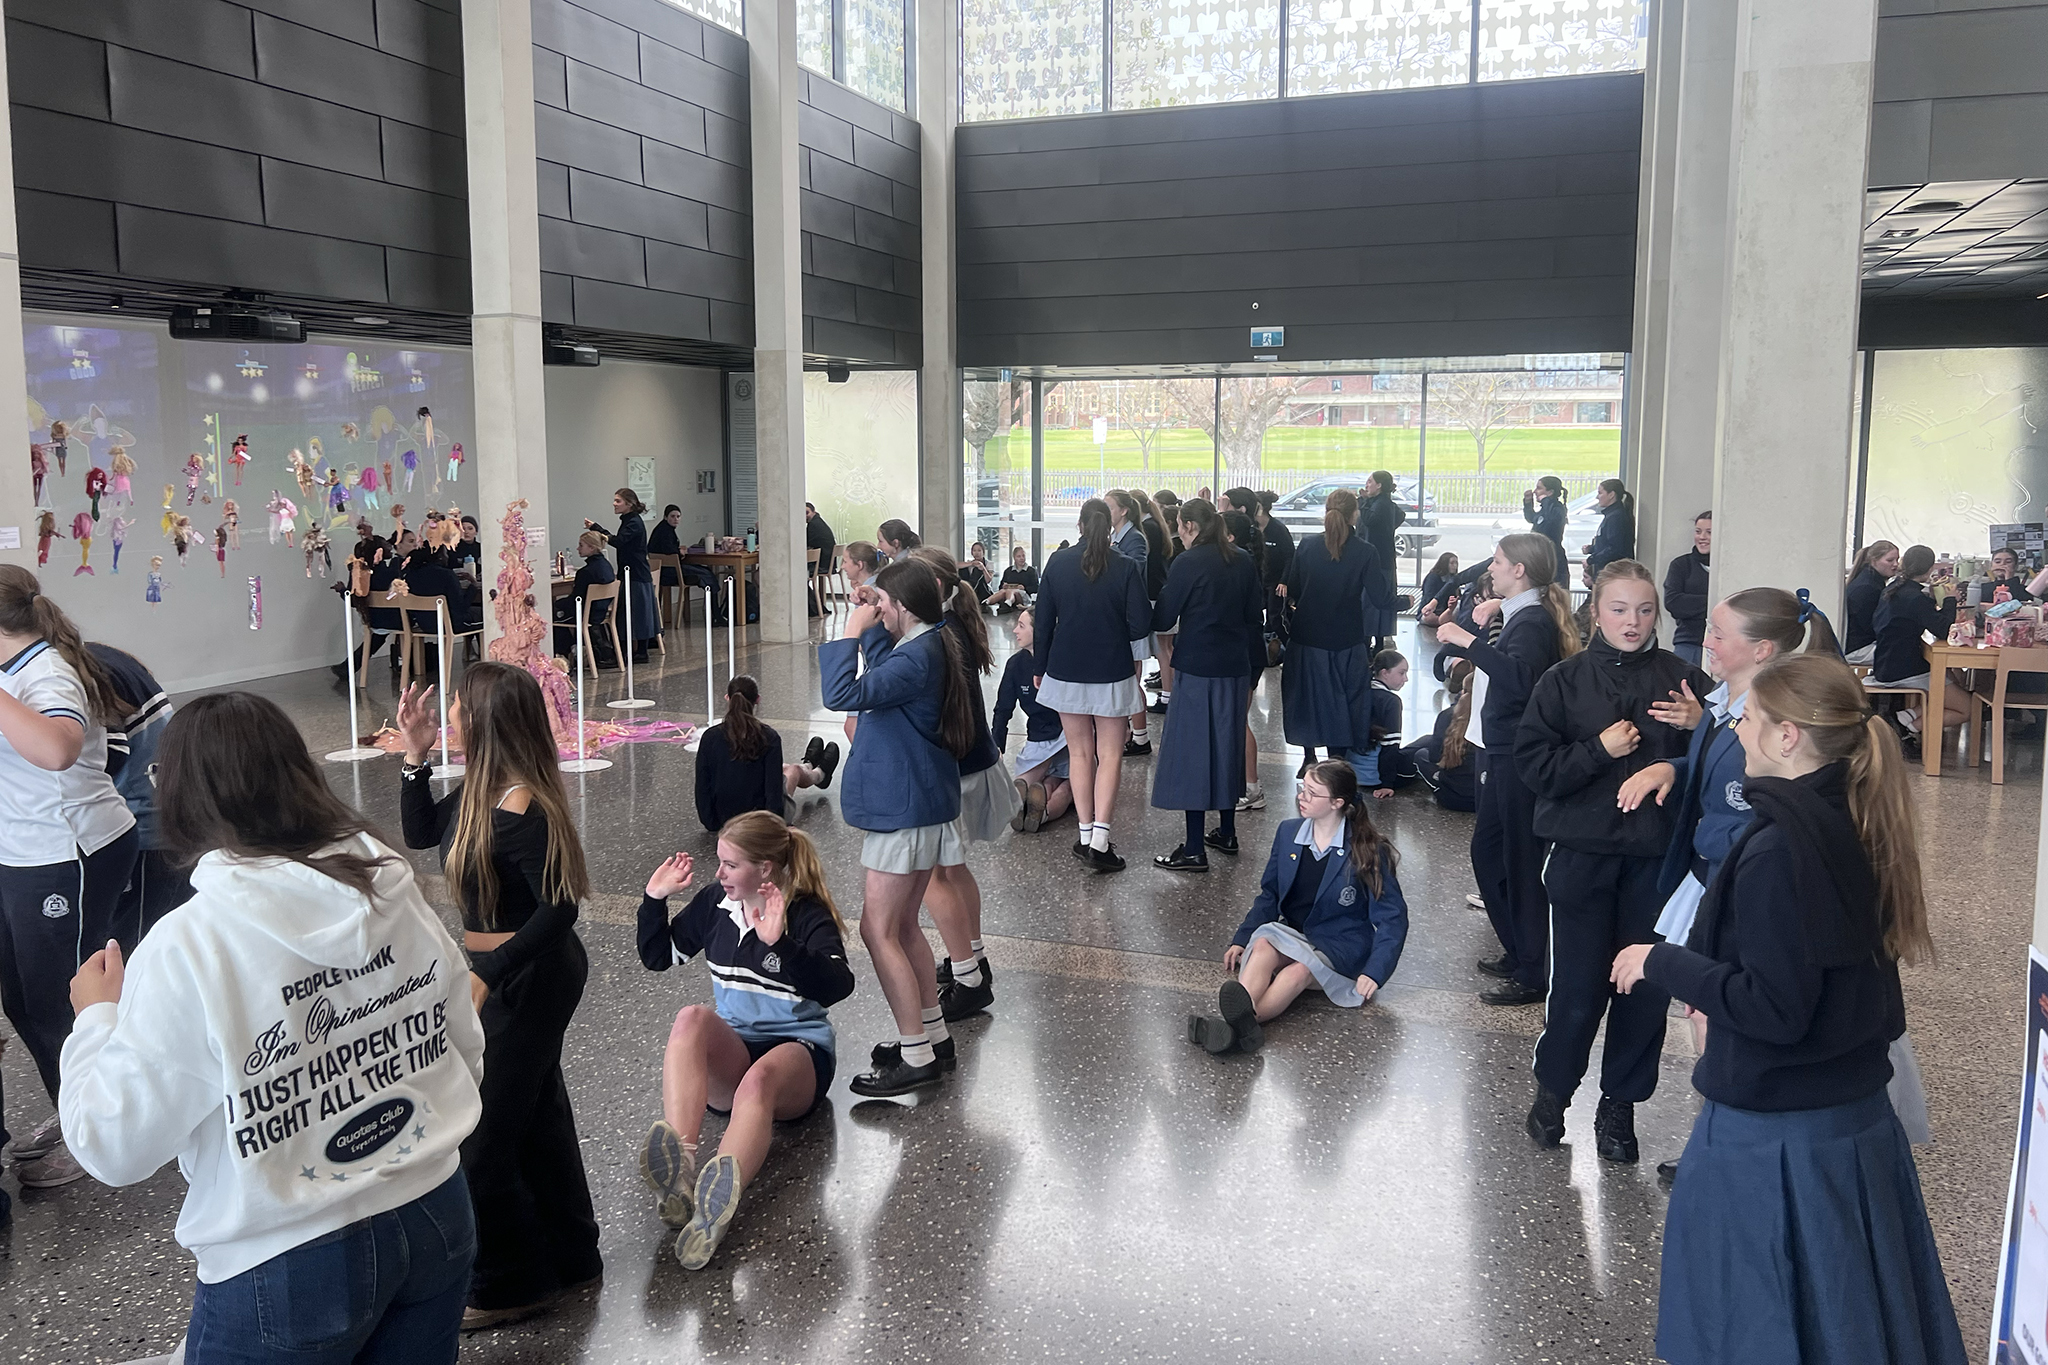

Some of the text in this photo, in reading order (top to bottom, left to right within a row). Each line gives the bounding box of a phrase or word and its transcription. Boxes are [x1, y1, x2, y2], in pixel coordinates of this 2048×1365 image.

[281, 967, 342, 1006] PEOPLE
[305, 958, 438, 1046] Opinionated.
[225, 998, 449, 1124] I JUST HAPPEN TO BE
[235, 1027, 449, 1159] RIGHT ALL THE TIME
[336, 1104, 405, 1148] Quotes Club
